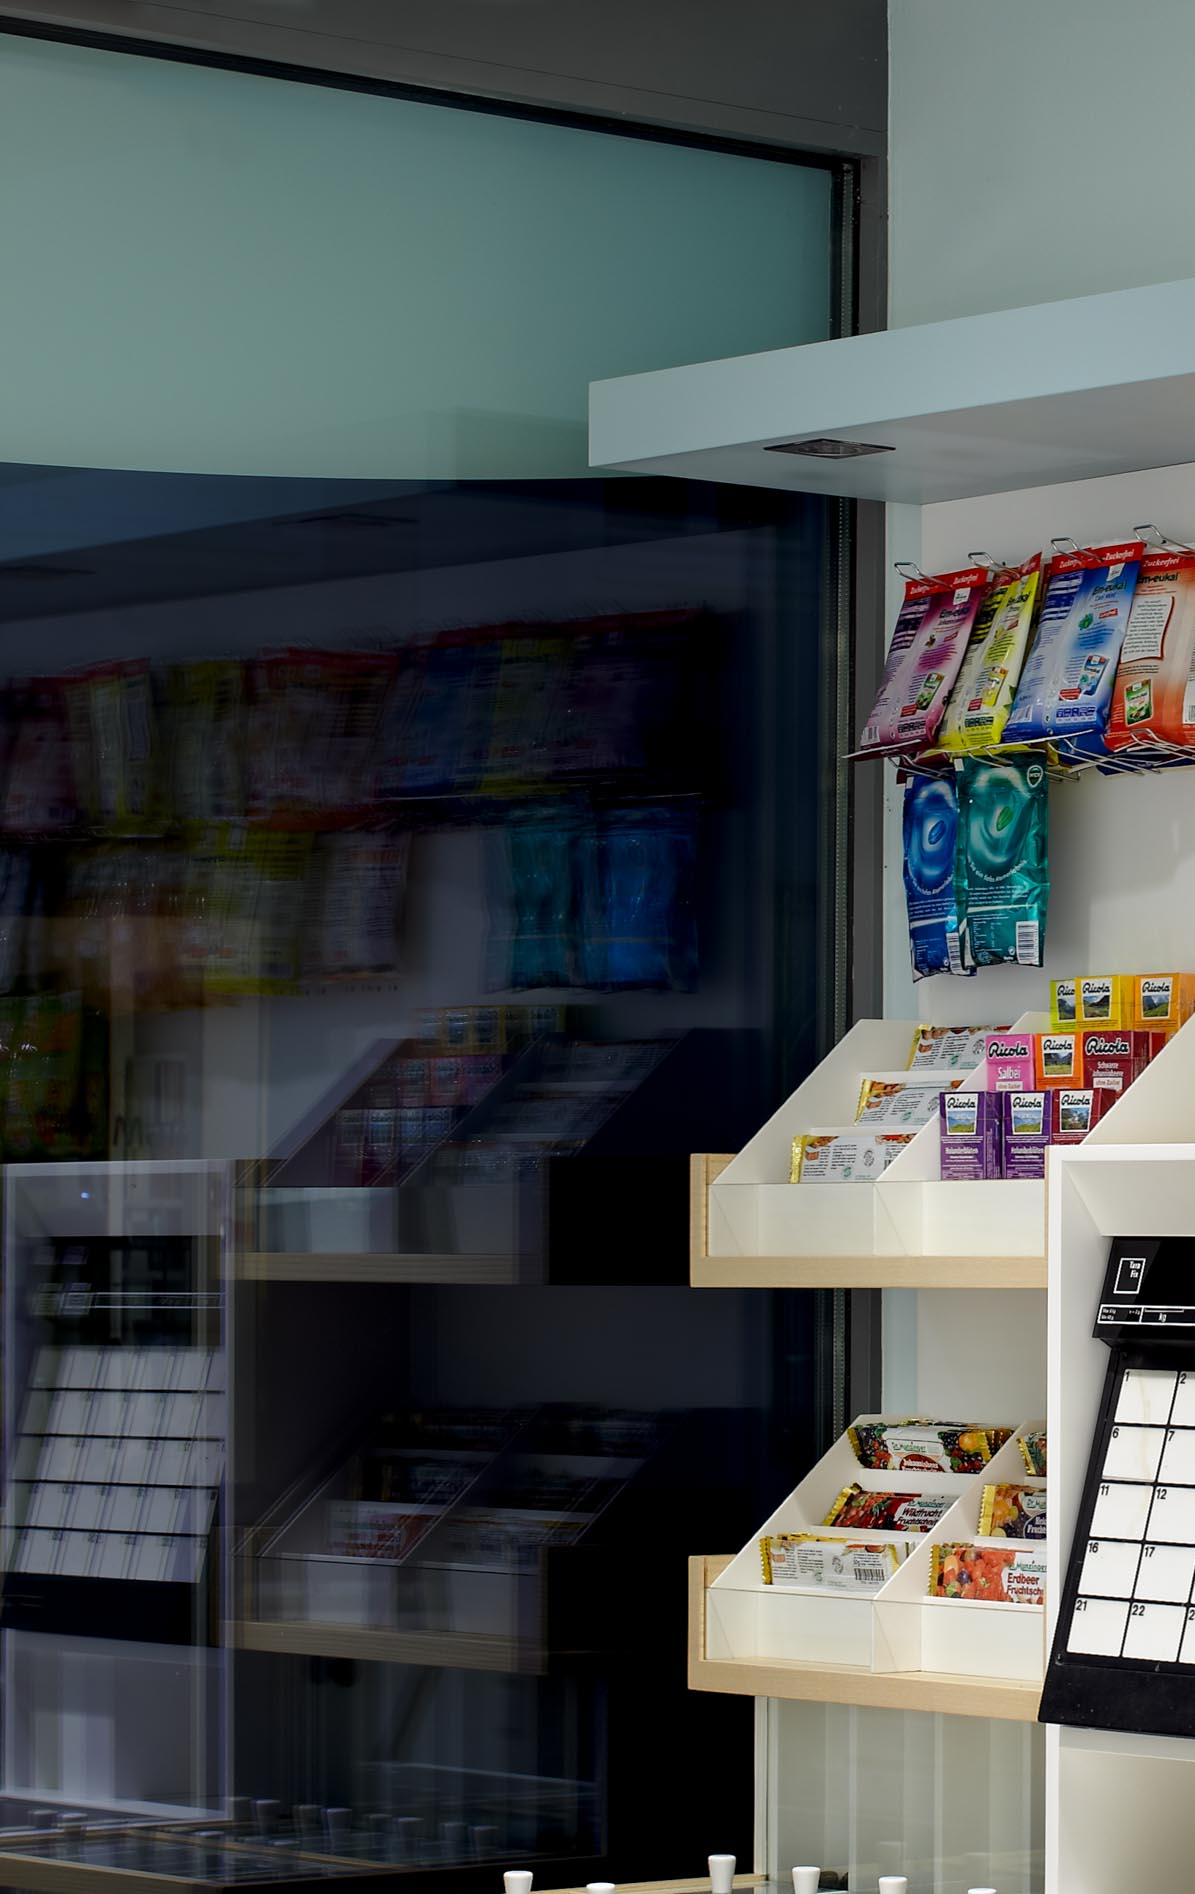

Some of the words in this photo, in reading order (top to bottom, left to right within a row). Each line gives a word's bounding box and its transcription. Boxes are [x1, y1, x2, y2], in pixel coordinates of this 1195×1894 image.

[1083, 981, 1110, 994] Ricola
[1142, 981, 1170, 994] Ricola
[989, 1041, 1028, 1058] Ricola
[1043, 1038, 1073, 1051] Ricola
[1086, 1037, 1130, 1055] Ricola
[997, 1066, 1021, 1080] Salbei
[947, 1097, 976, 1109] Ricola
[1012, 1096, 1042, 1109] Ricola
[1061, 1094, 1090, 1106] Ricola
[1158, 1312, 1167, 1323] kg
[1125, 1371, 1130, 1382] 1
[1179, 1373, 1187, 1384] 2
[1112, 1427, 1120, 1439] 6
[1168, 1430, 1175, 1442] 7
[1100, 1484, 1110, 1496] 11
[1156, 1488, 1167, 1500] 12
[1088, 1541, 1099, 1553] 16
[1144, 1546, 1155, 1557] 17
[1007, 1572, 1040, 1585] Erdbeer
[1075, 1600, 1087, 1611] 21
[1132, 1604, 1145, 1616] 22
